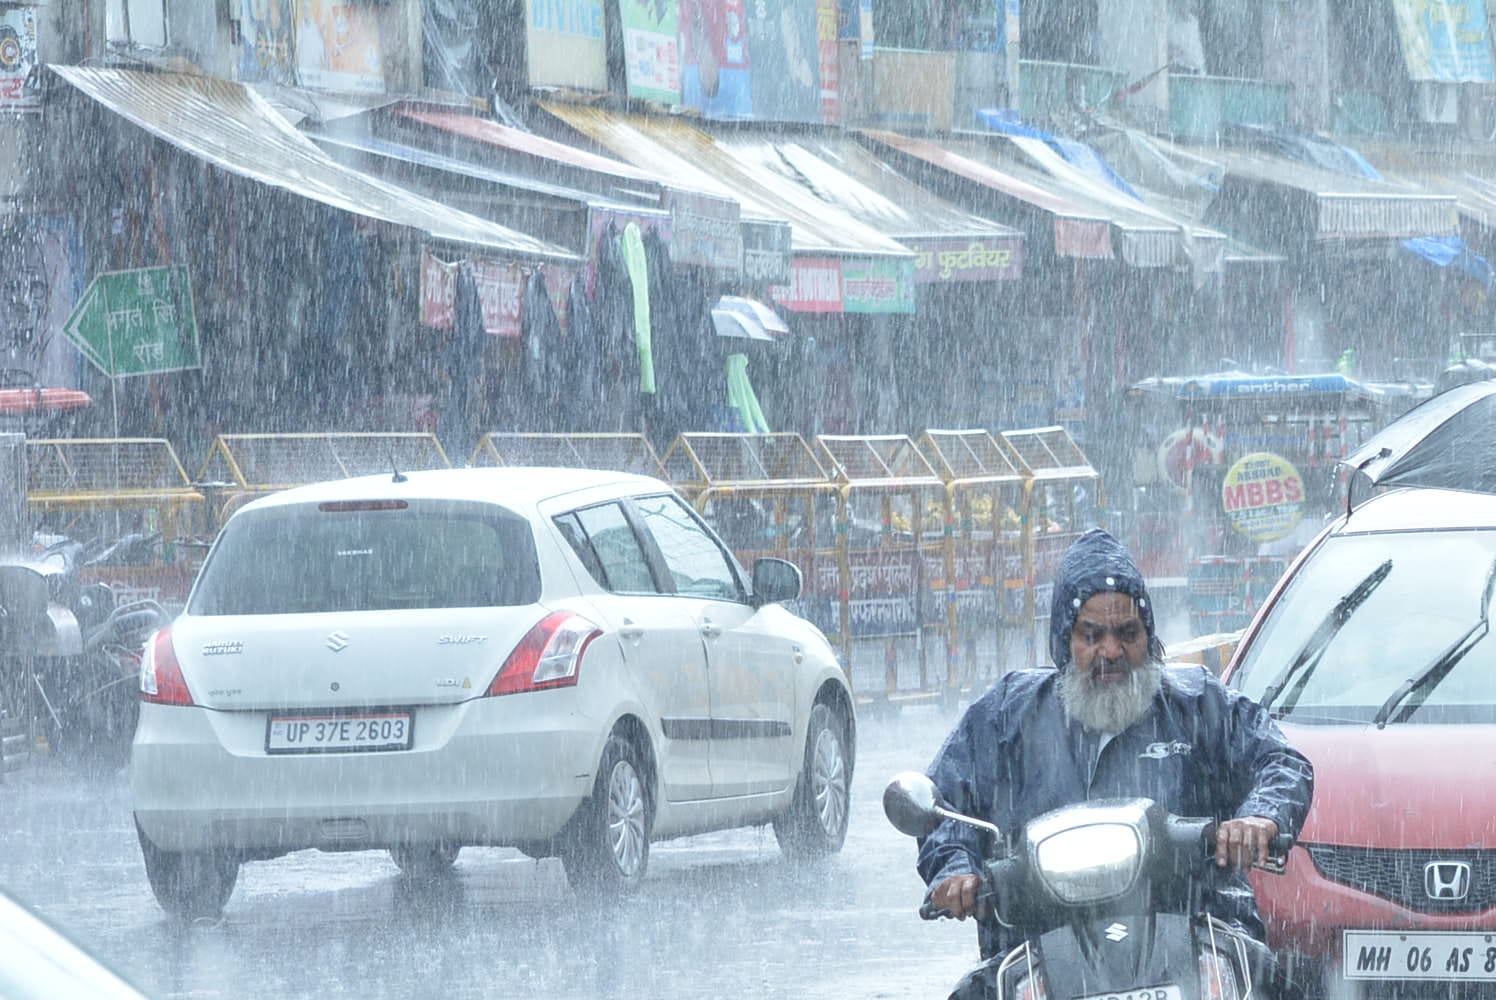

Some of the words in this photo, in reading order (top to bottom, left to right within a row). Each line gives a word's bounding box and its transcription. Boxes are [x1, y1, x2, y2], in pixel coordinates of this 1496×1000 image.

[939, 243, 1010, 278] फुटवियर
[1225, 476, 1302, 512] MBBS
[438, 634, 488, 645] SWIFT
[286, 724, 310, 742] UP
[315, 721, 351, 742] 37E
[355, 720, 404, 741] 2603
[1356, 946, 1392, 971] MH
[1406, 946, 1432, 972] 06
[1445, 947, 1473, 973] AS
